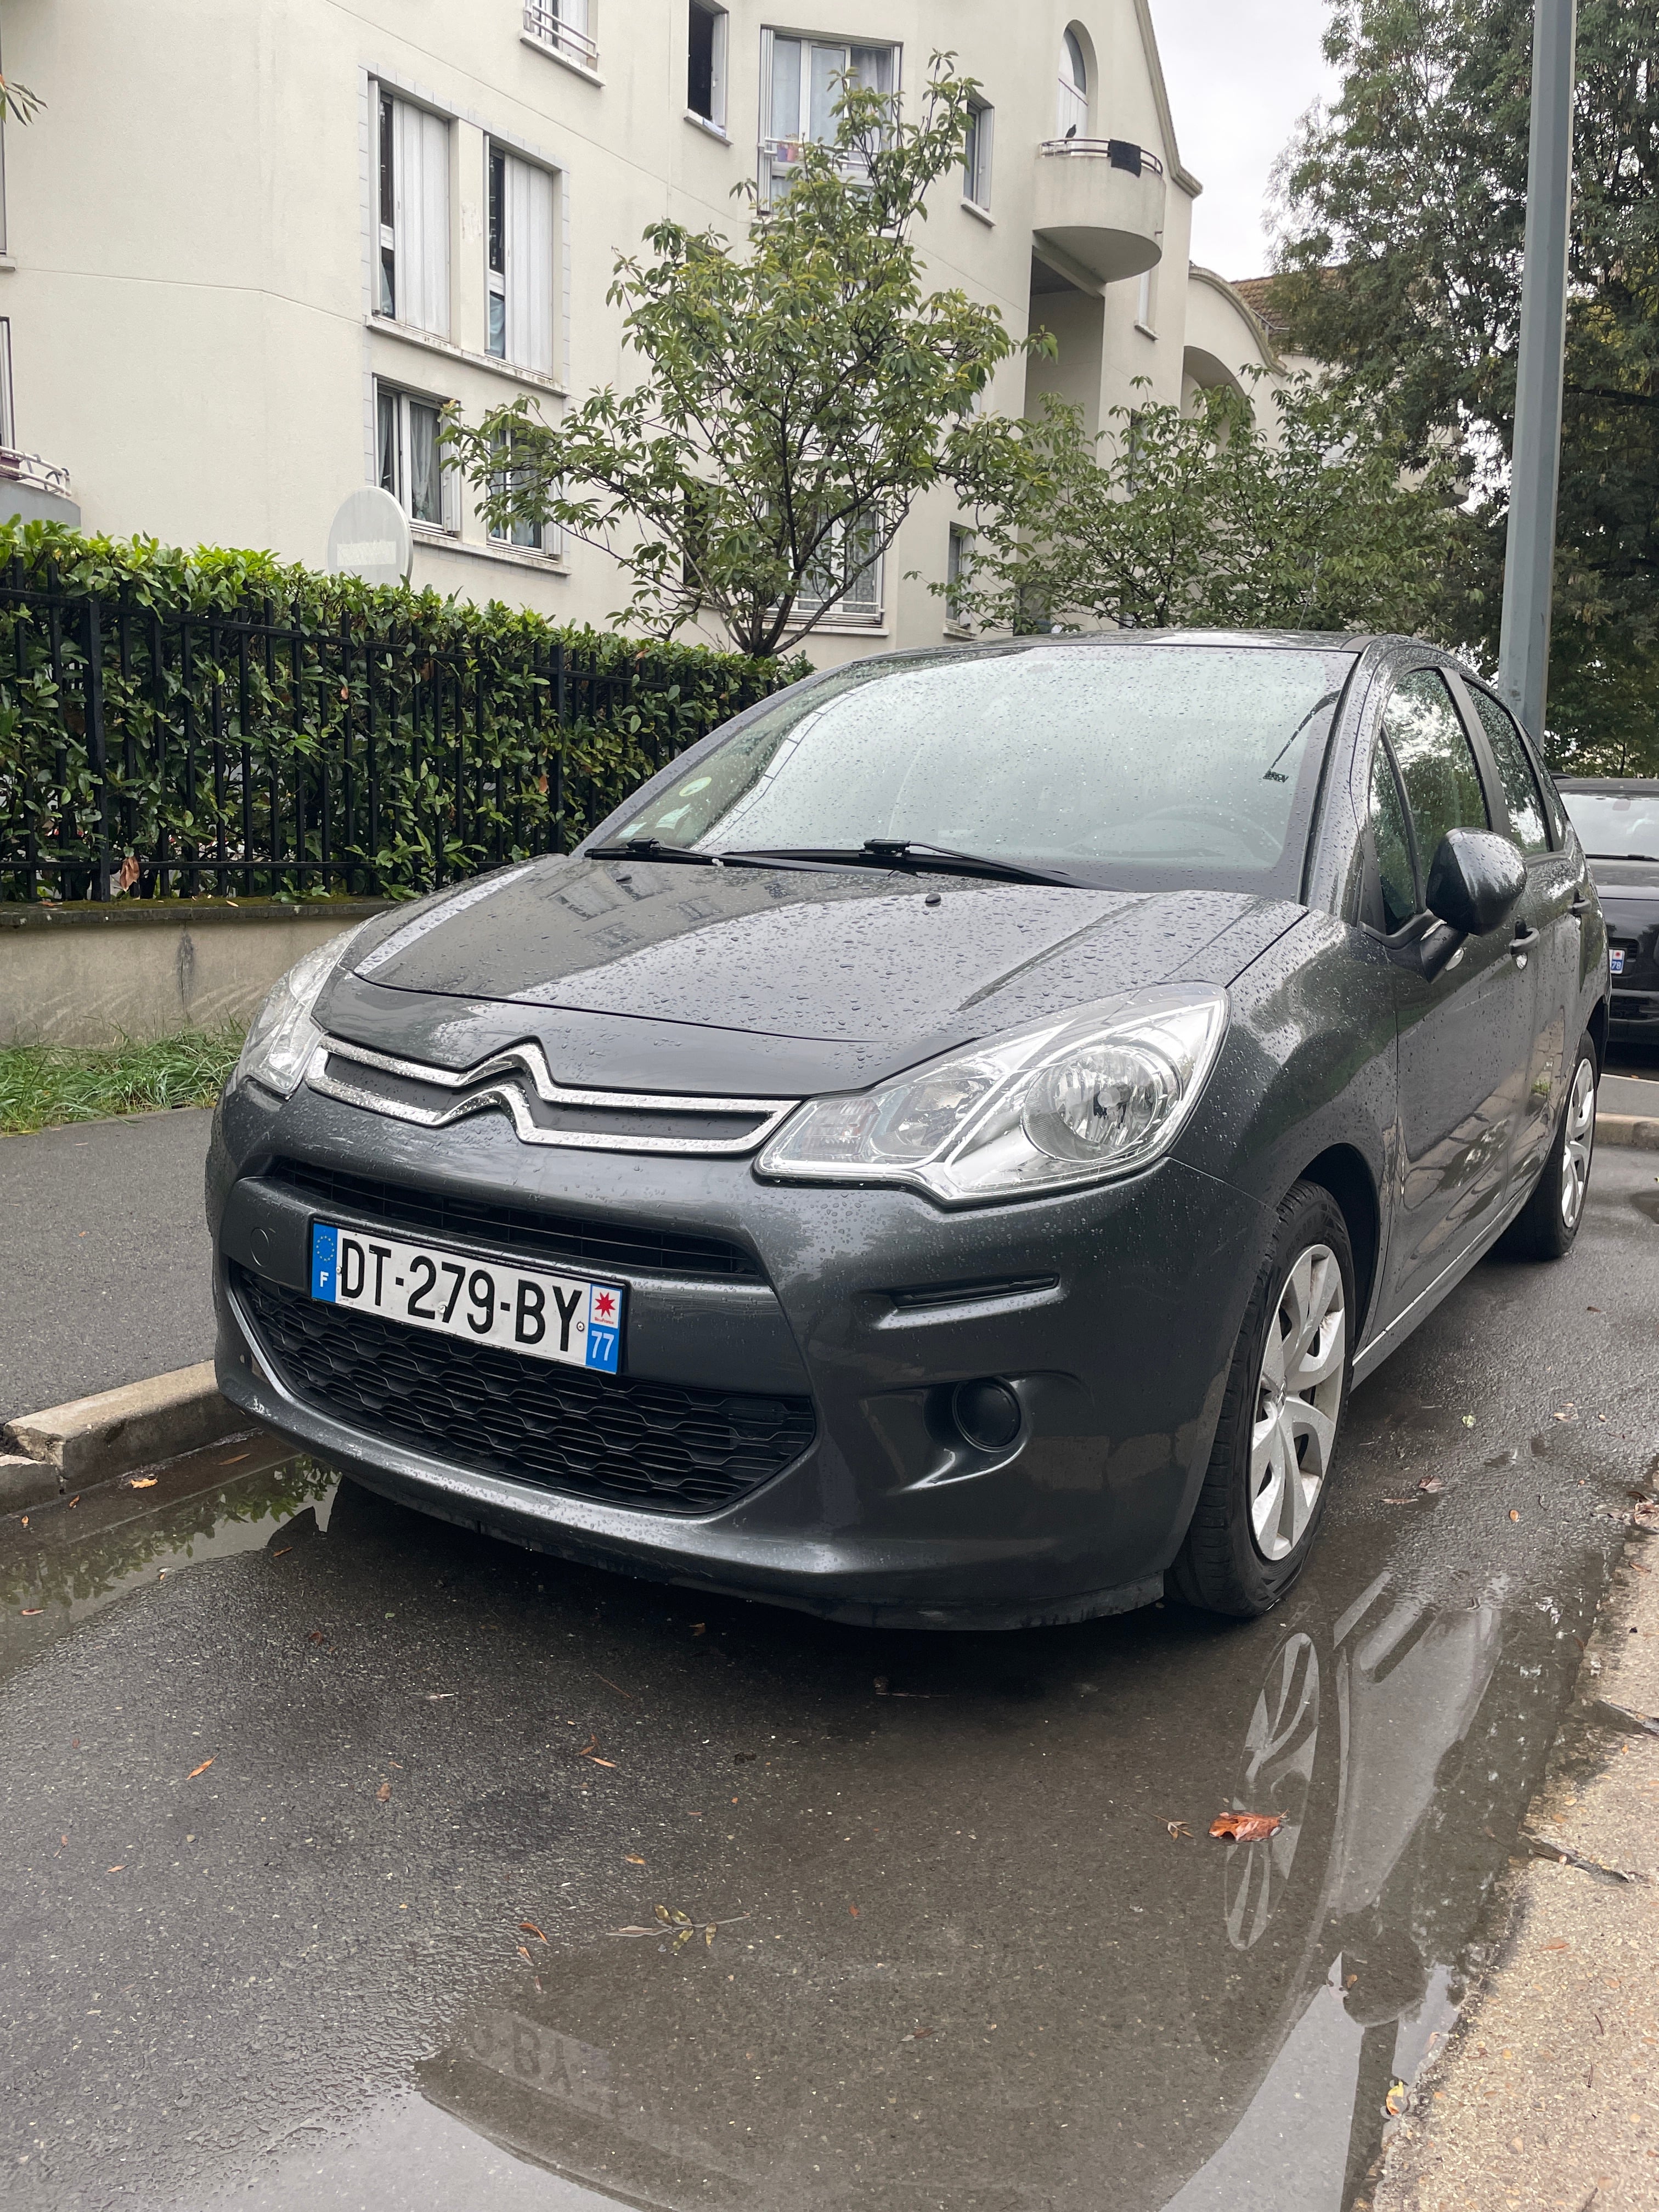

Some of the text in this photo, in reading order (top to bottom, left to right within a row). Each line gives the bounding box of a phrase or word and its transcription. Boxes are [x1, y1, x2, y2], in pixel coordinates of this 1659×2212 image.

[1611, 961, 1622, 970] 78
[320, 1271, 329, 1288] F
[341, 1238, 583, 1352] DT-279-BY
[591, 1330, 614, 1361] 77
